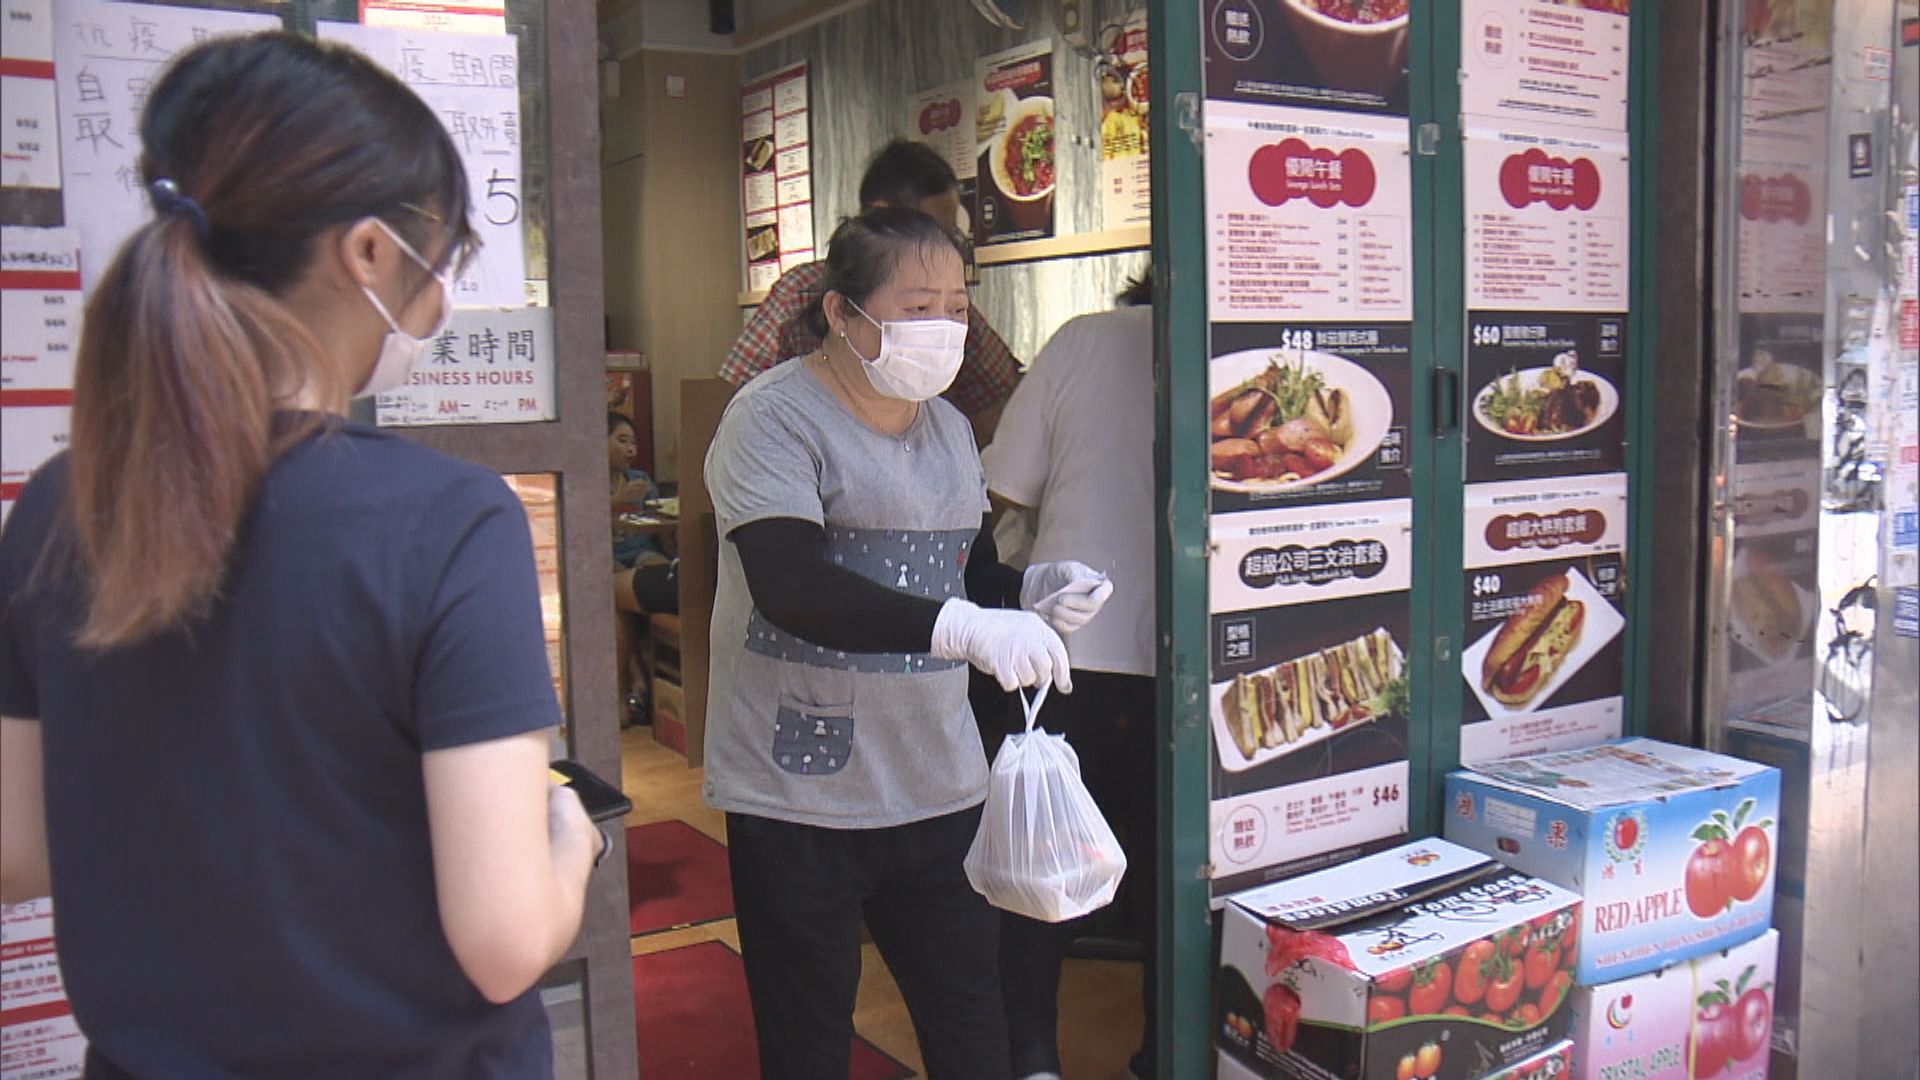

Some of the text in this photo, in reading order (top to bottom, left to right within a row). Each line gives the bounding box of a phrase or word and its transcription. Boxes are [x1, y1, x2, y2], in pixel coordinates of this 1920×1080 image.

[484, 167, 519, 225] 5
[431, 327, 535, 365] 業時間
[1281, 327, 1314, 350] $48
[1473, 324, 1500, 346] $60
[476, 370, 534, 385] HOURS
[438, 400, 460, 414] AM
[517, 398, 538, 411] PM
[1244, 543, 1384, 577] 超級公司三文治套餐
[1473, 575, 1501, 597] $40
[1373, 784, 1400, 807] $46
[1402, 873, 1529, 917] Tomatoes
[1594, 902, 1630, 934] RED
[1631, 887, 1684, 924] APPLE
